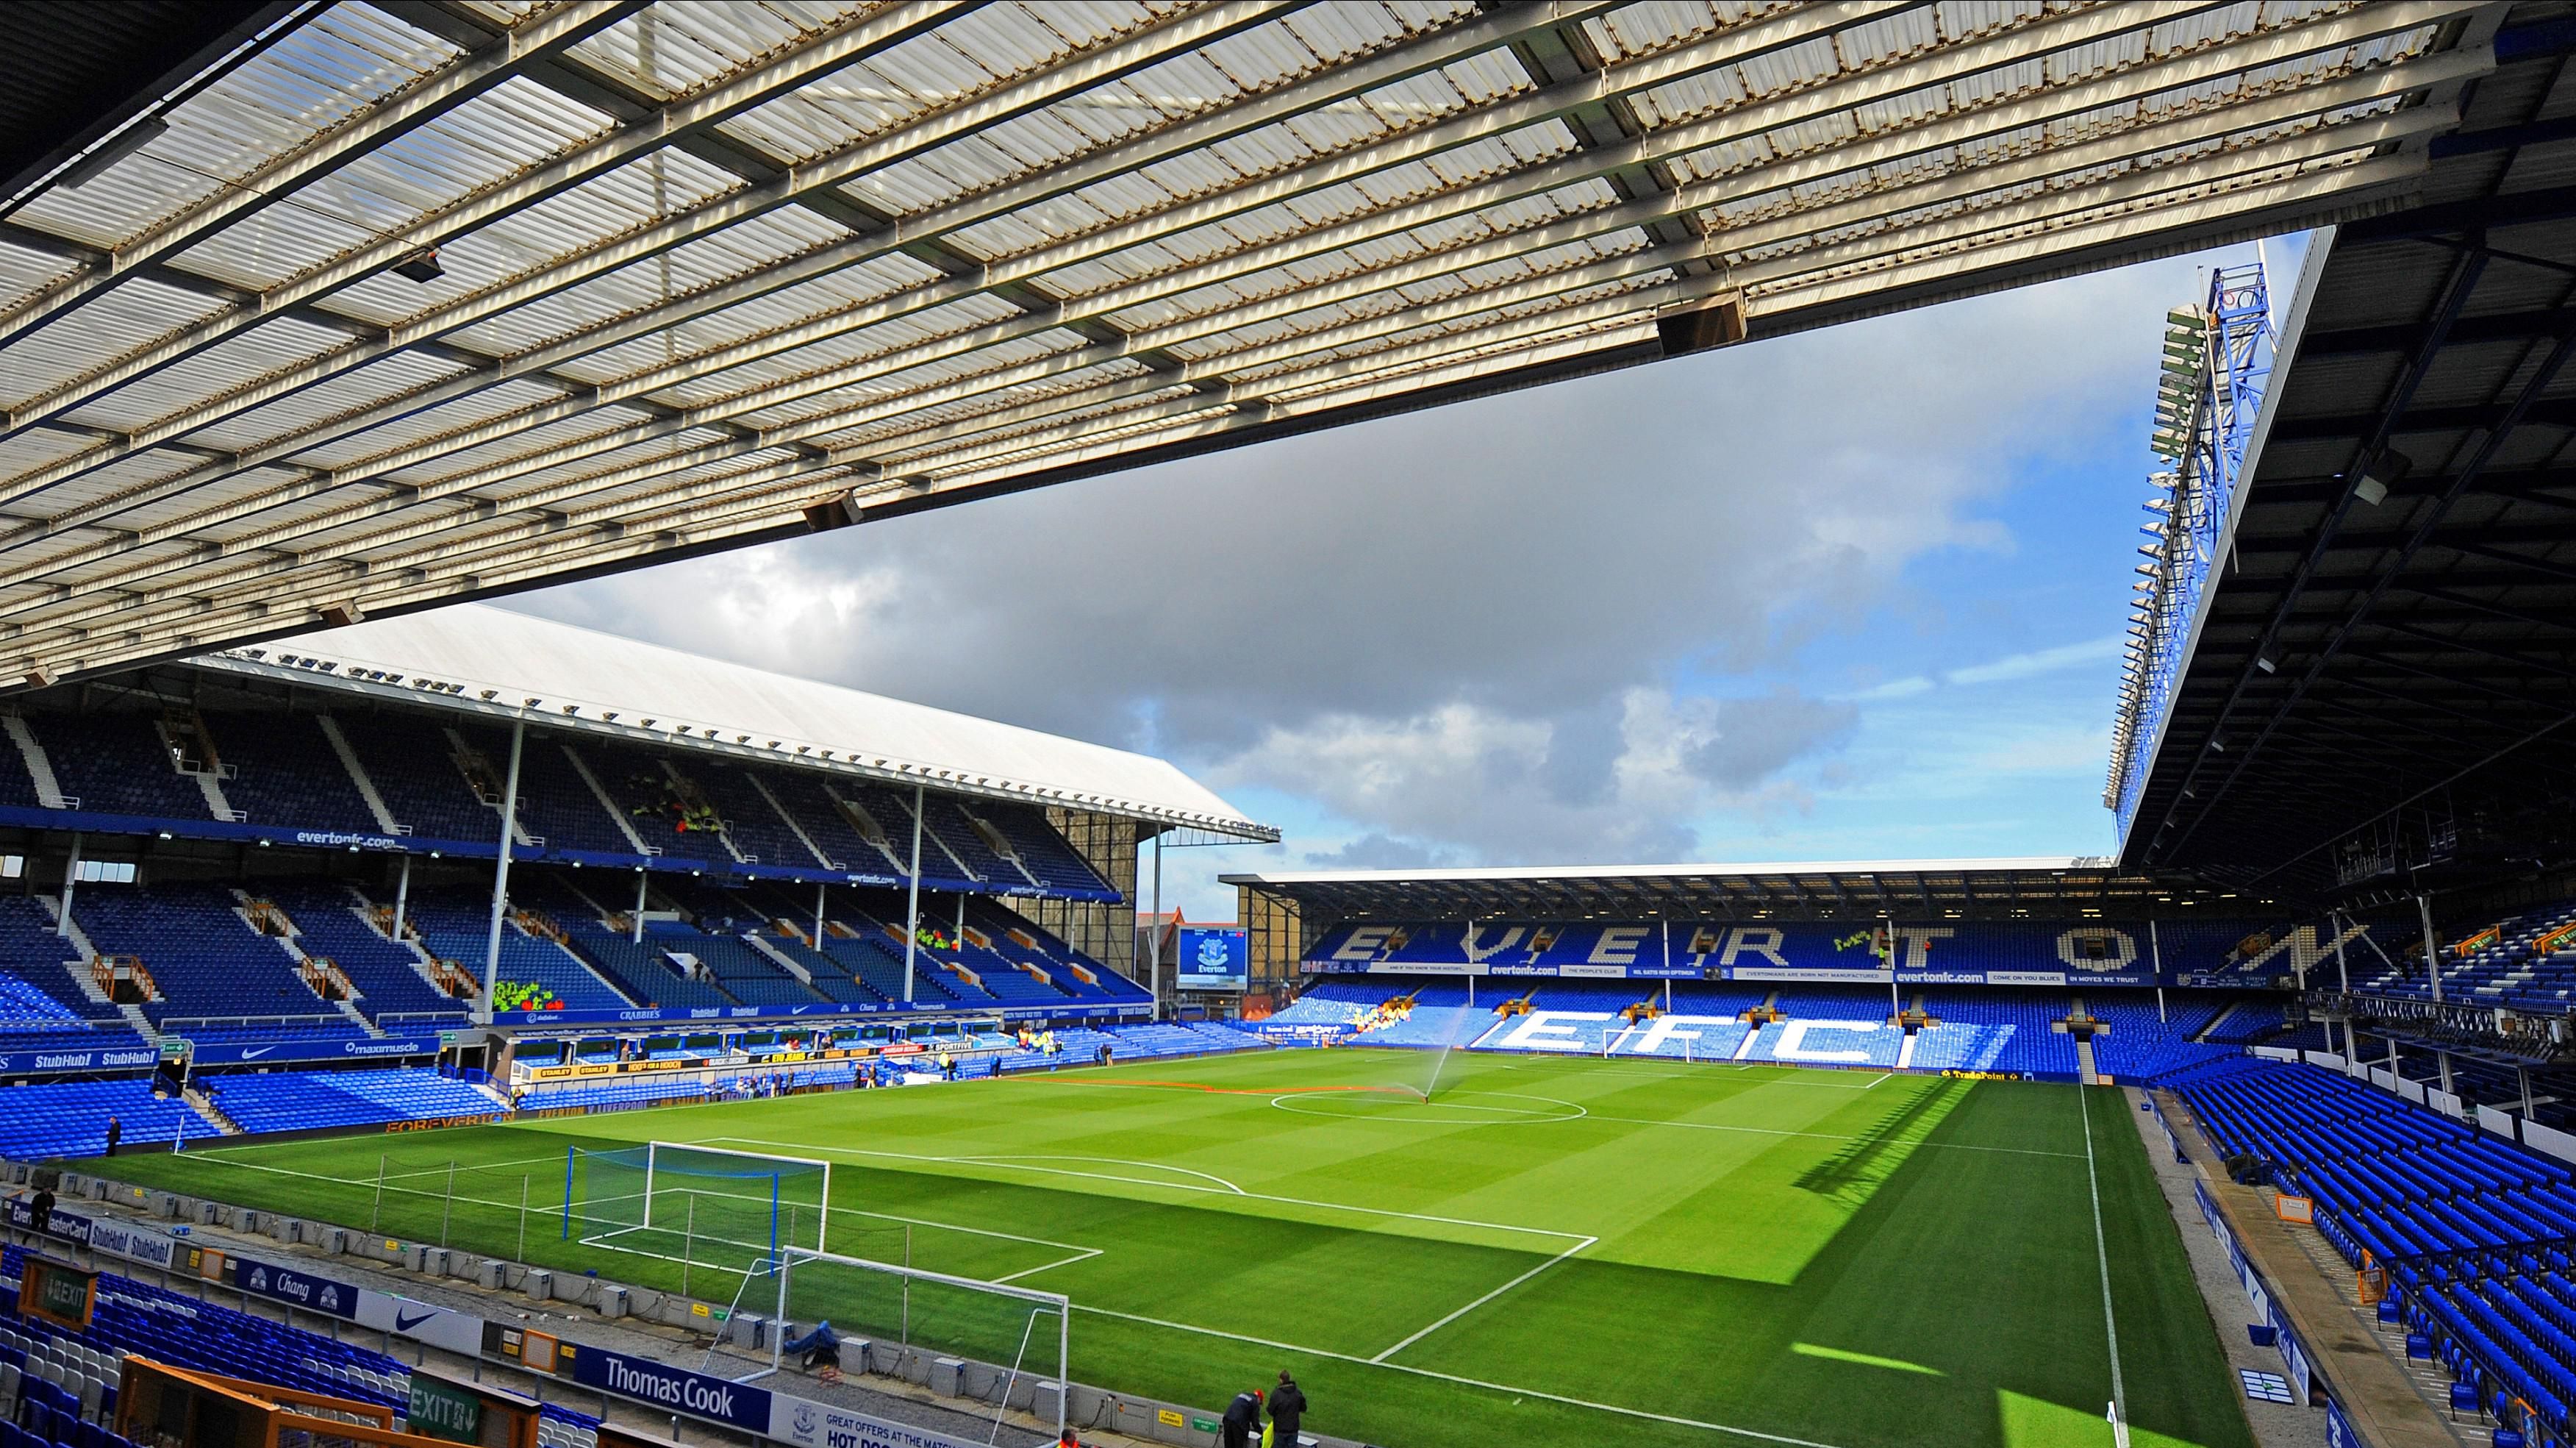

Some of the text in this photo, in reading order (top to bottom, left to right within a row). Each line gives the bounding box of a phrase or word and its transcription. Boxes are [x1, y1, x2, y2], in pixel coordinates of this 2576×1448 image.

[297, 832, 396, 847] evertonfc.com
[1198, 965, 1227, 973] Everton
[1491, 965, 1557, 976] evertonfc.com
[1897, 971, 1983, 983] evertonfc.com
[355, 1042, 419, 1054] maximuscle
[35, 1053, 91, 1068] StubHub!
[102, 1051, 155, 1066] StubHub!
[542, 1069, 570, 1077] STANLEY
[1953, 1071, 2005, 1080] TradePoint
[538, 1106, 584, 1118] EVERTON
[598, 1101, 648, 1113] LIVERPOOL
[385, 1111, 515, 1133] FOREVERTON
[48, 1215, 88, 1240] asterCard
[93, 1226, 129, 1252] StubHub!
[131, 1236, 169, 1263] StubHub!
[62, 1282, 86, 1308] EXIT
[277, 1273, 310, 1302] Chang
[606, 1358, 734, 1418] Thomas Cook
[409, 1388, 453, 1425] EXIT
[792, 1432, 814, 1444] Everton
[826, 1413, 854, 1430] GREAT
[855, 1422, 889, 1439] OFFERS
[890, 1430, 902, 1443] AT
[904, 1433, 921, 1448] THE
[828, 1430, 856, 1448] HOT
